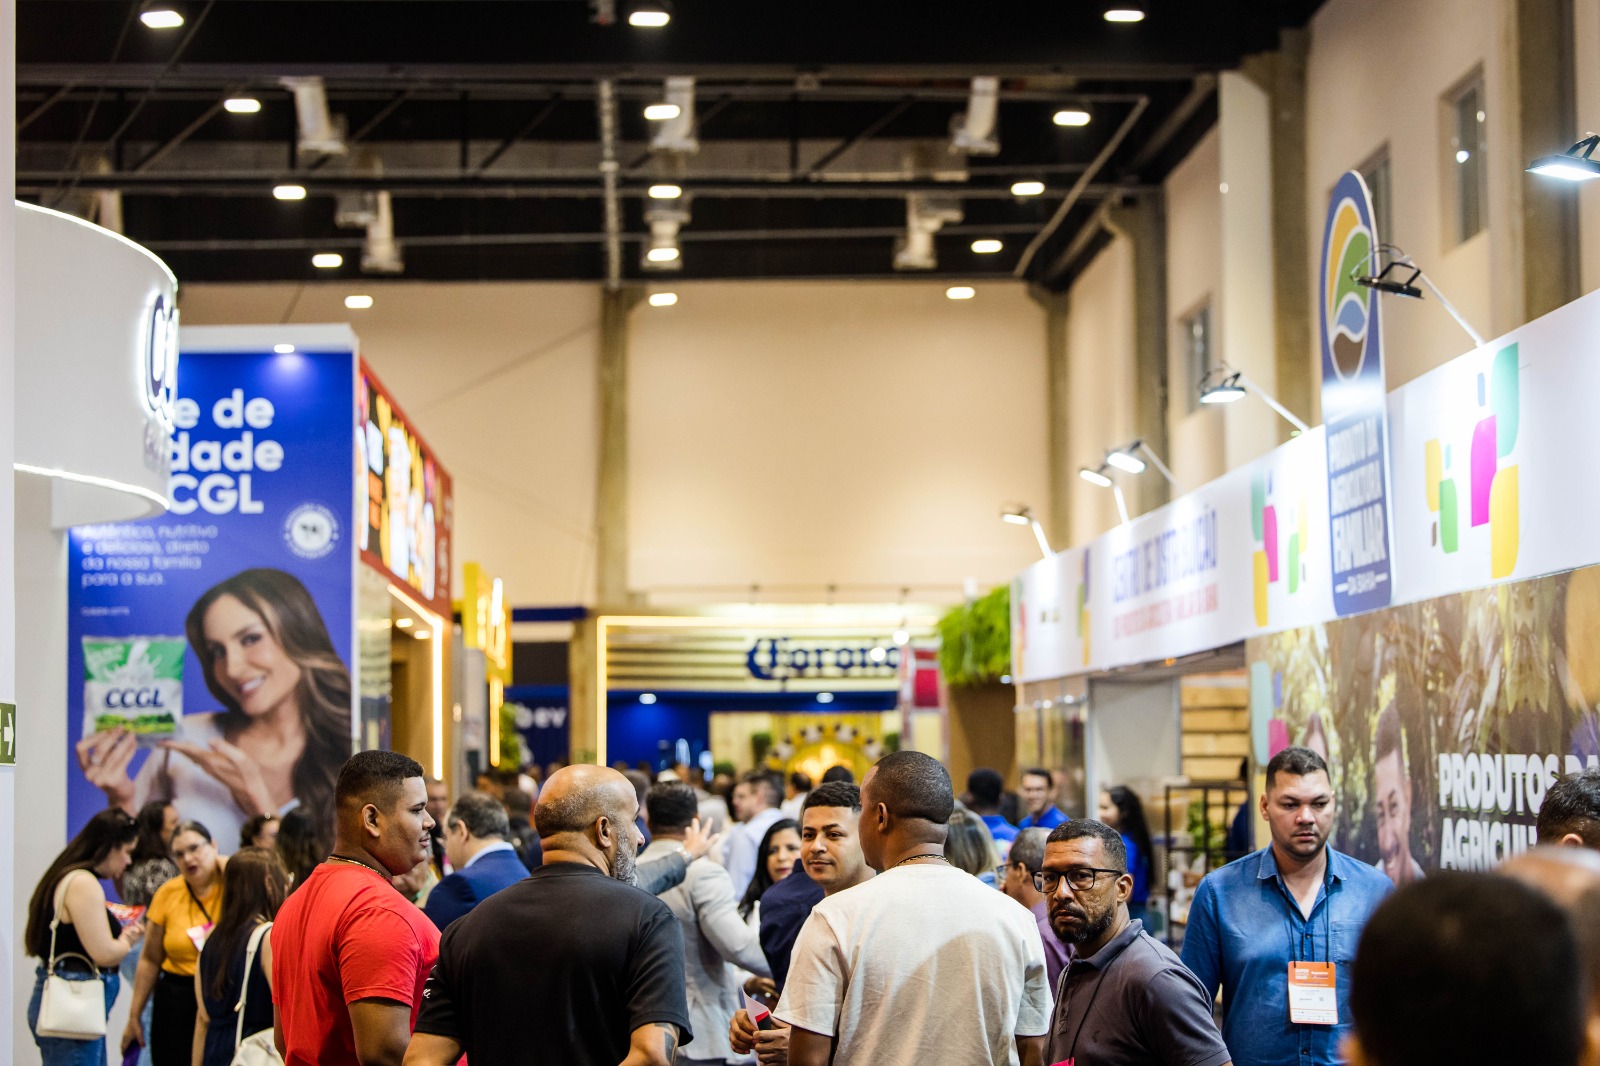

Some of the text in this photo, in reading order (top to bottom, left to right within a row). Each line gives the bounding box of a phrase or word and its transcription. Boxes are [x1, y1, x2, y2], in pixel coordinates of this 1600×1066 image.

[212, 388, 275, 430] de
[1332, 502, 1387, 574] FAMILIAR
[106, 556, 150, 571] nossa
[105, 687, 164, 708] CCGL
[1438, 752, 1560, 817] PRODUTOS
